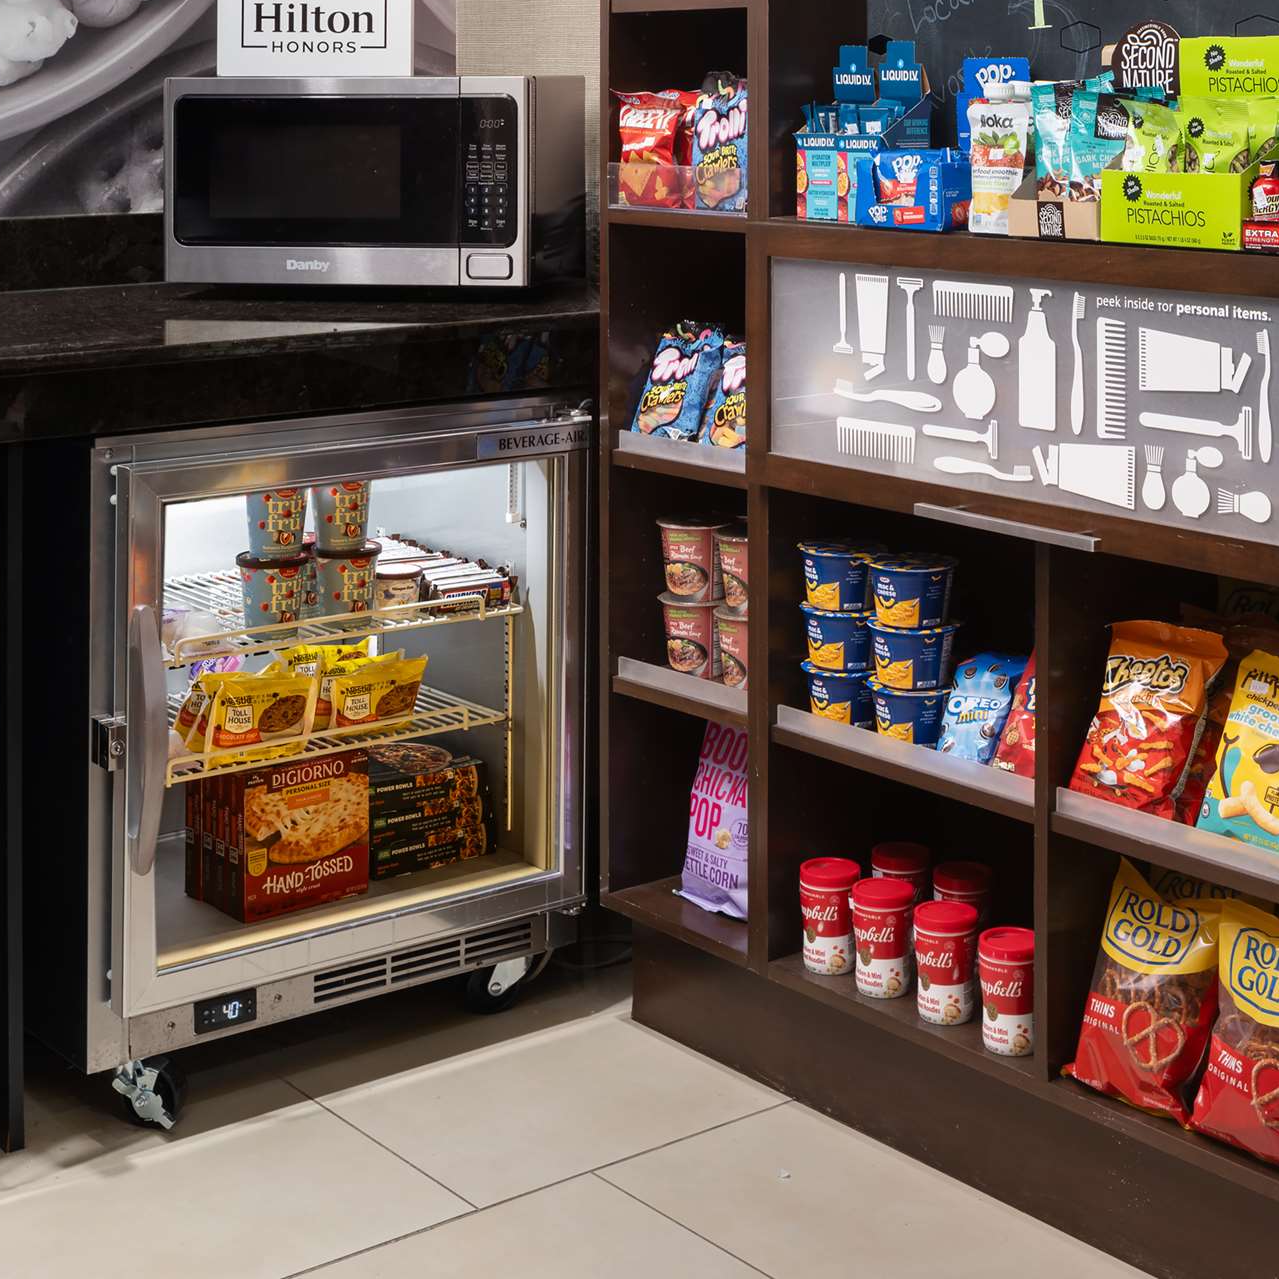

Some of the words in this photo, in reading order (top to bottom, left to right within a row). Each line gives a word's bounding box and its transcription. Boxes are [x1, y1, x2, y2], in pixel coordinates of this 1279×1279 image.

[253, 2, 375, 34] Hilton
[271, 40, 357, 54] HONORS
[1122, 41, 1175, 70] SECOND
[1229, 59, 1264, 69] Wonderful
[836, 74, 862, 86] LIQUID
[1122, 69, 1174, 95] NATURE
[1146, 191, 1182, 201] Wonderful
[1127, 210, 1205, 227] PISTACHIOS
[1245, 229, 1278, 237] EXTRA
[286, 259, 330, 272] Danby
[1096, 295, 1121, 311] peek
[1124, 296, 1156, 311] inside
[1176, 301, 1229, 321] personal
[1232, 304, 1272, 322] items.
[499, 430, 586, 451] BEVERAGE-AIR
[345, 703, 369, 711] HOUSE
[948, 696, 1001, 713] OREO
[227, 716, 252, 724] HOUSE
[1228, 711, 1254, 730] white
[286, 784, 318, 795] PERSONAL
[318, 780, 331, 788] SIZE
[376, 784, 395, 793] POWER
[395, 782, 413, 790] BOWLS
[710, 855, 728, 869] SALTY
[262, 856, 354, 894] HAND-TOSSED
[1122, 893, 1191, 934] ROLD
[1113, 918, 1182, 958] GOLD
[1090, 998, 1115, 1018] THINS
[1208, 1063, 1249, 1092] ORIGINAL
